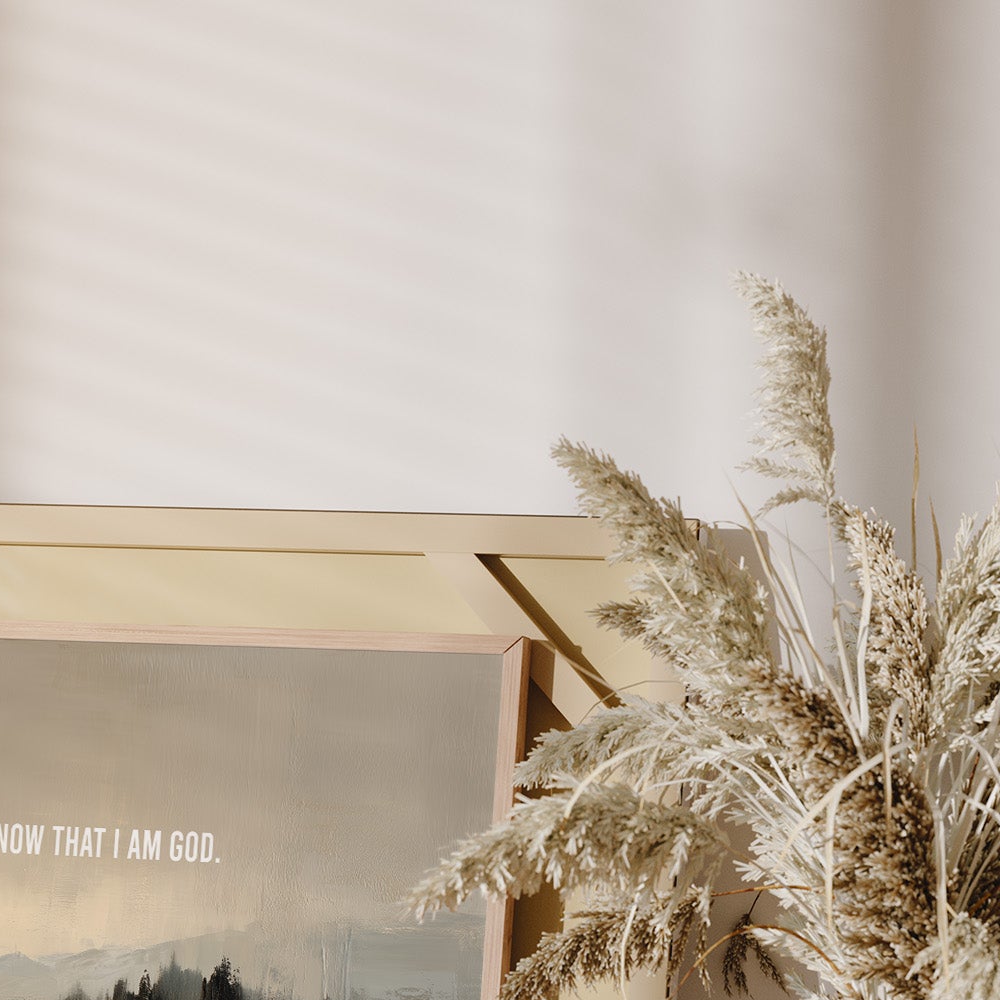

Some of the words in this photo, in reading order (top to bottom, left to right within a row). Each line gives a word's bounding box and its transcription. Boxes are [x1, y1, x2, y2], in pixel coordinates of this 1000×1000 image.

[52, 825, 106, 858] THAT
[113, 828, 121, 859] I
[127, 829, 162, 861] AM
[169, 830, 221, 864] GOD.
